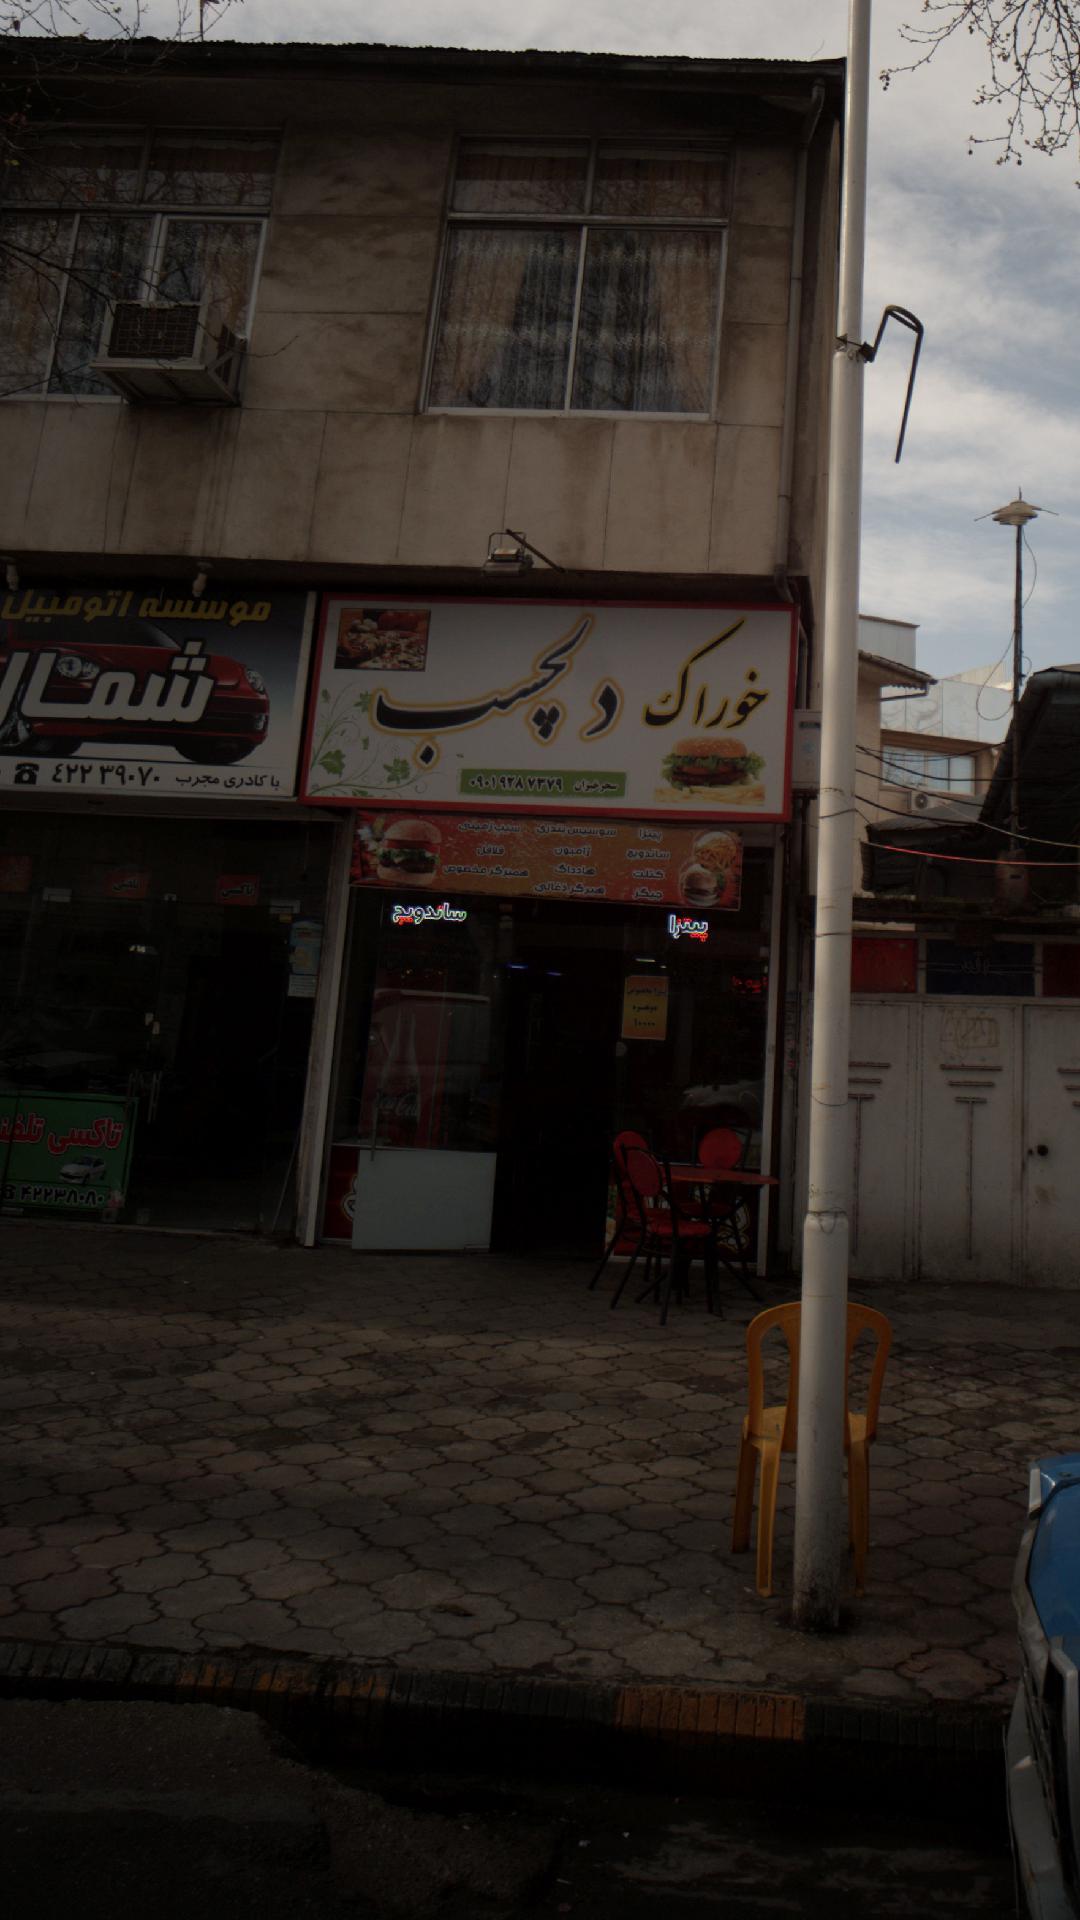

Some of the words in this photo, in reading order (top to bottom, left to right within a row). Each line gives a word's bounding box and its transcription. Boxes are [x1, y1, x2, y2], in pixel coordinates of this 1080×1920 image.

[1, 589, 134, 624] اتومبیل
[139, 596, 272, 628] موسسه
[642, 618, 768, 728] خوراک
[174, 774, 221, 789] مجرب
[223, 774, 266, 790] کادری
[270, 776, 281, 789] با
[458, 821, 493, 835] زمینی
[495, 823, 522, 835] سیب
[567, 824, 617, 839] سوسیس
[638, 827, 663, 844] پیتزا
[476, 844, 505, 857] فلافل
[626, 848, 671, 860] ساندویچ
[444, 864, 488, 876] مخصوص
[632, 869, 665, 880] کتلت
[391, 901, 469, 927] ساندویچ
[667, 912, 710, 943] پیتزا
[0, 1112, 46, 1144] تلفن
[47, 1116, 125, 1156] تاکسی
